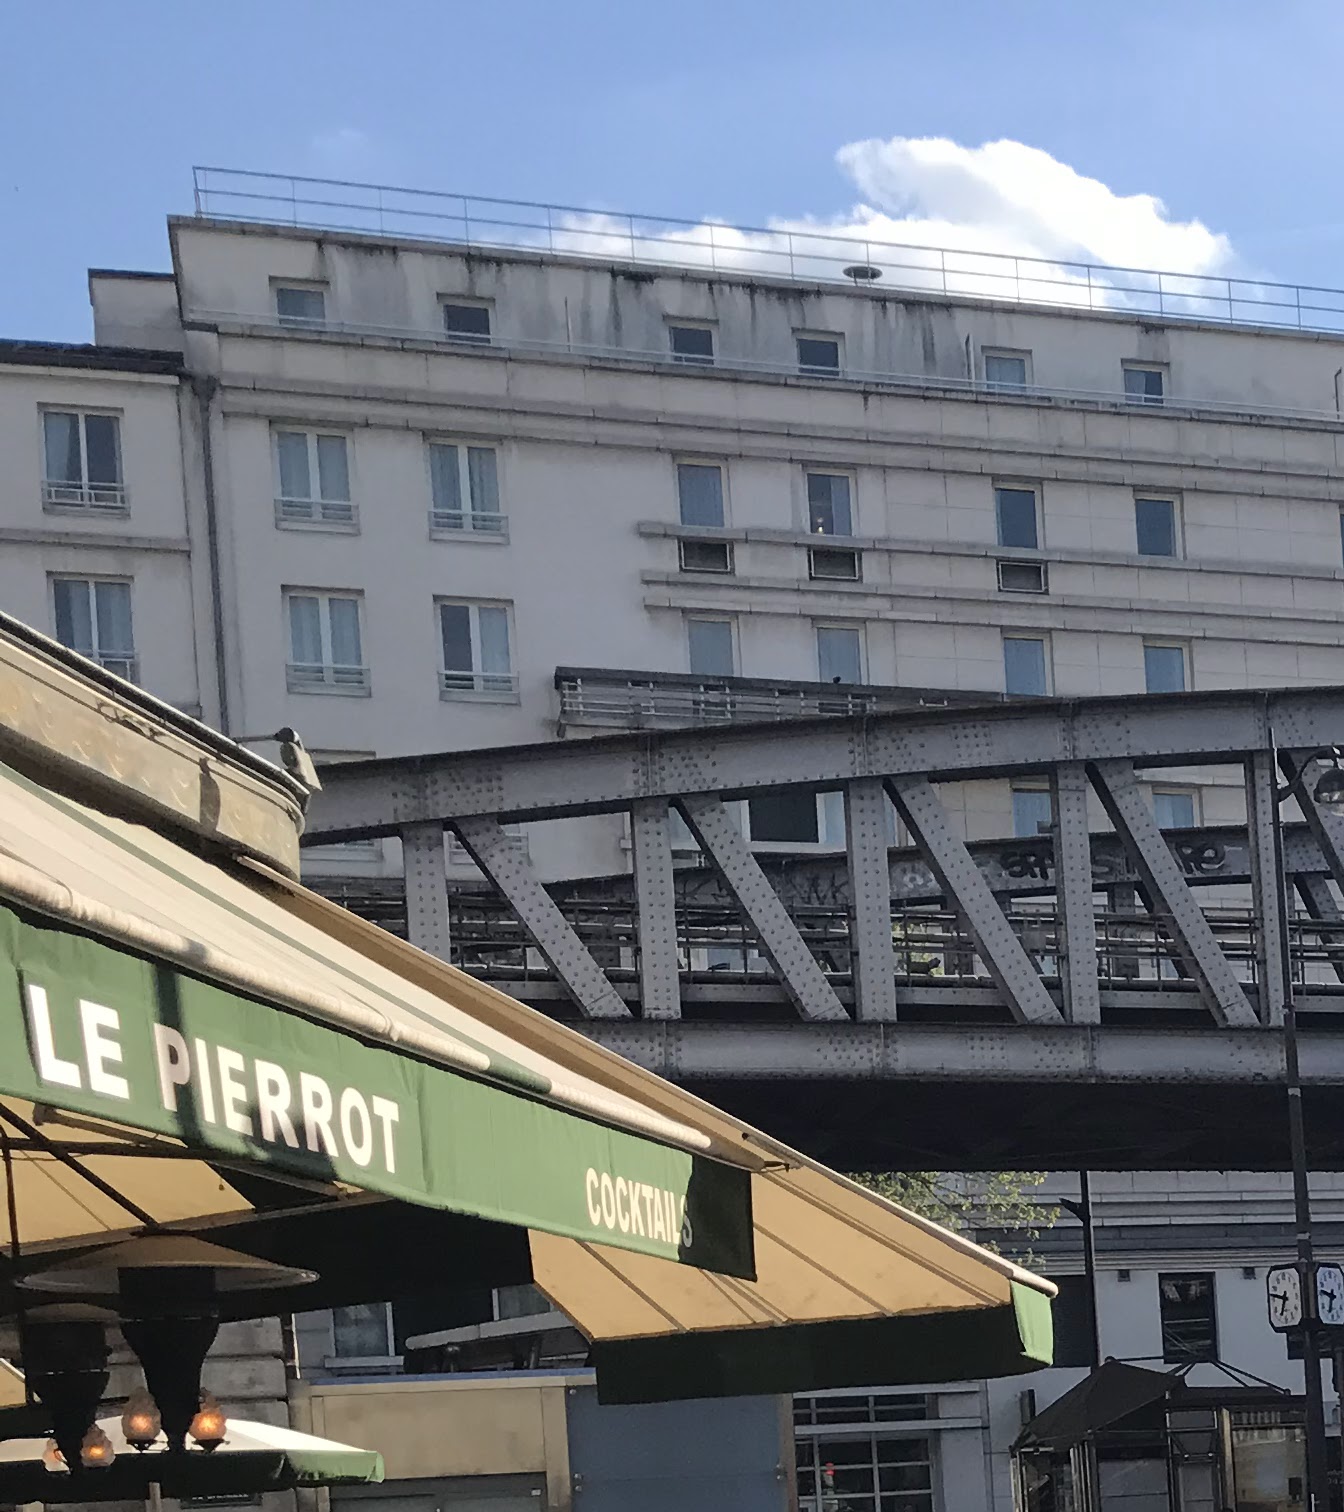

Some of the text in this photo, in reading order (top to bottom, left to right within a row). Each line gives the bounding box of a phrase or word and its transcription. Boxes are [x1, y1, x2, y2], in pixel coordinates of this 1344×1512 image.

[26, 983, 400, 1174] LE PIERROT
[586, 1167, 694, 1249] COCKTAILS
